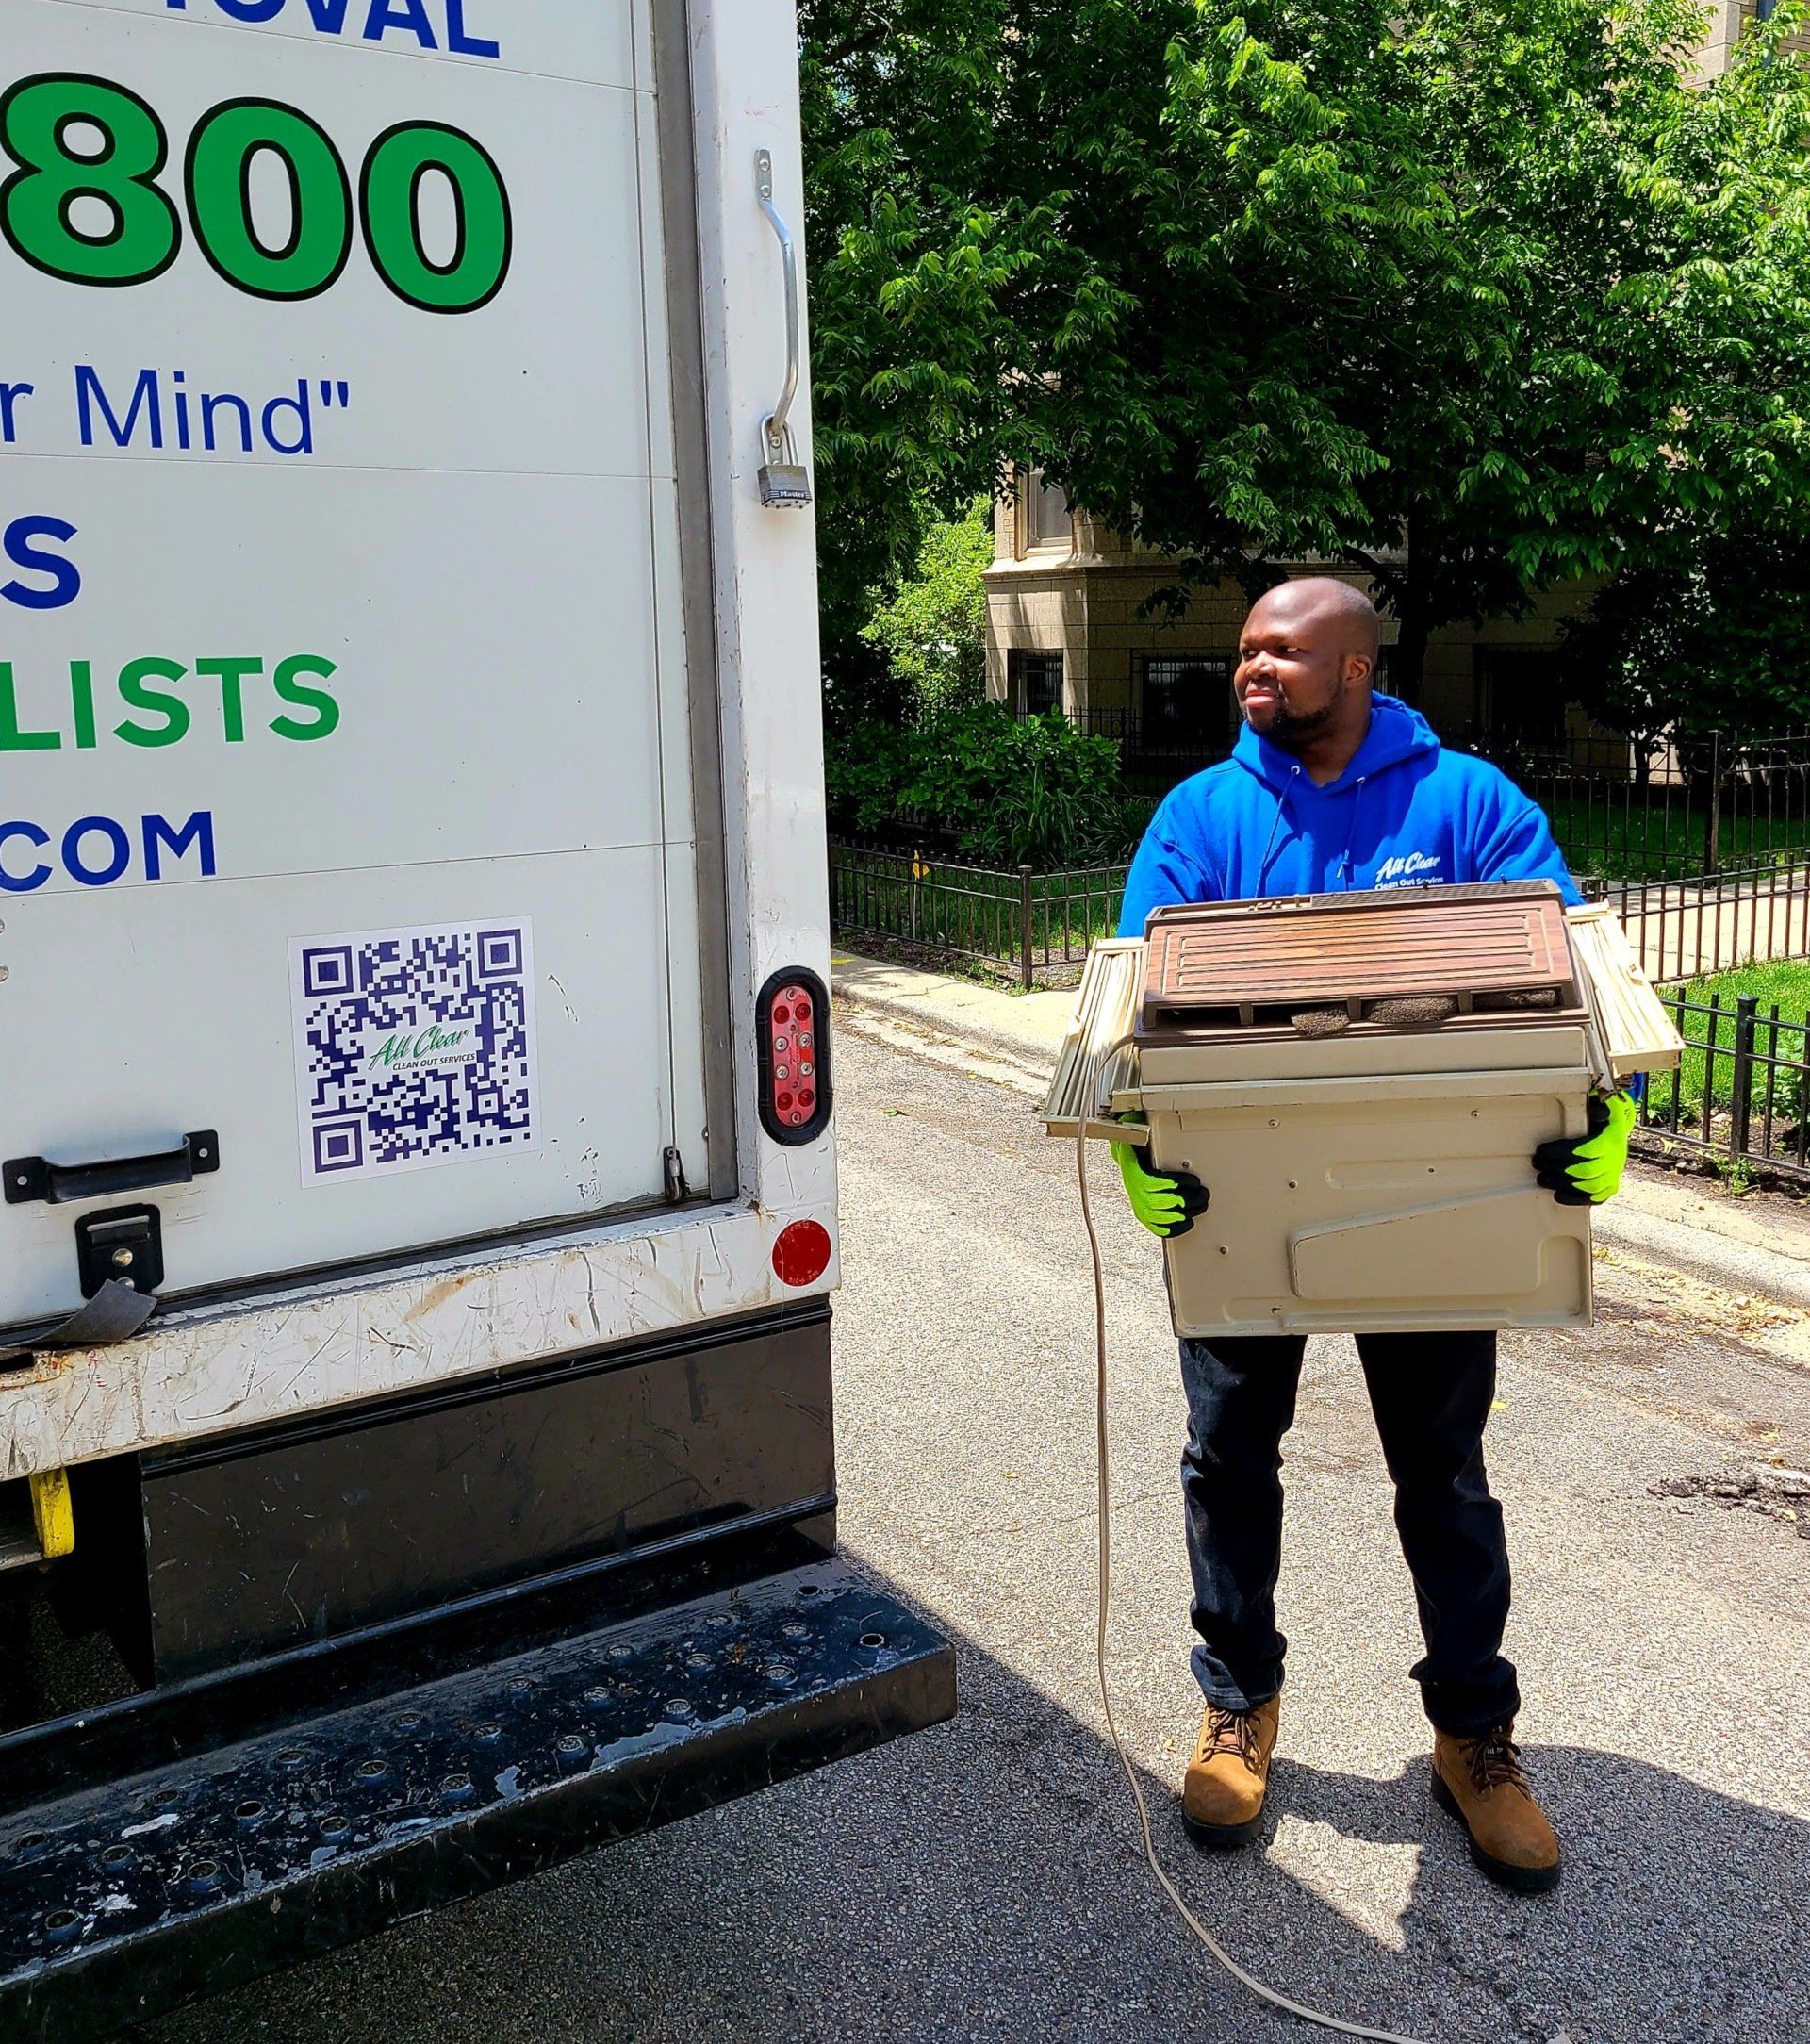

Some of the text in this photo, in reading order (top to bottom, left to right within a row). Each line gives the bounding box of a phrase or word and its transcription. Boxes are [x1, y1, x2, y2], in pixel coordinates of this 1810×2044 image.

[0, 72, 513, 315] 800
[74, 365, 349, 454] Mind"
[0, 515, 81, 610] S
[0, 654, 340, 751] LISTS
[0, 811, 216, 892] COM
[1374, 856, 1406, 882] All
[1374, 881, 1399, 890] Clean
[1399, 878, 1416, 886] Out
[368, 1025, 469, 1071] All Clear
[392, 1053, 475, 1071] CLEAN OUT SERVICES
